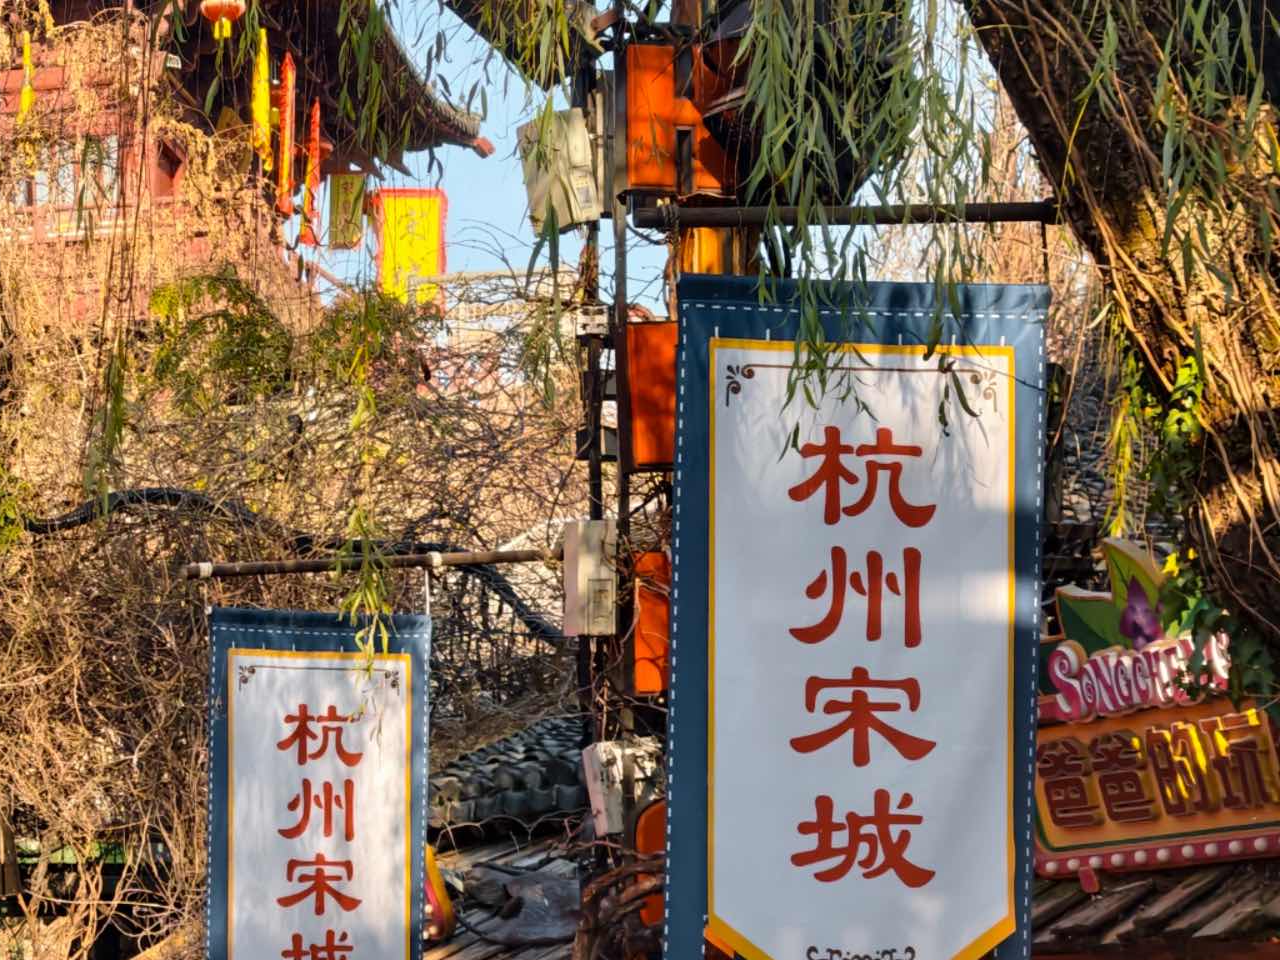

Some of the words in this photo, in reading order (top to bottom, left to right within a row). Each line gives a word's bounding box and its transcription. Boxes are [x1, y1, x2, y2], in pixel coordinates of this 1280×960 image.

[788, 426, 937, 888] 杭州宋城
[1038, 708, 1279, 827] 爸爸的玩
